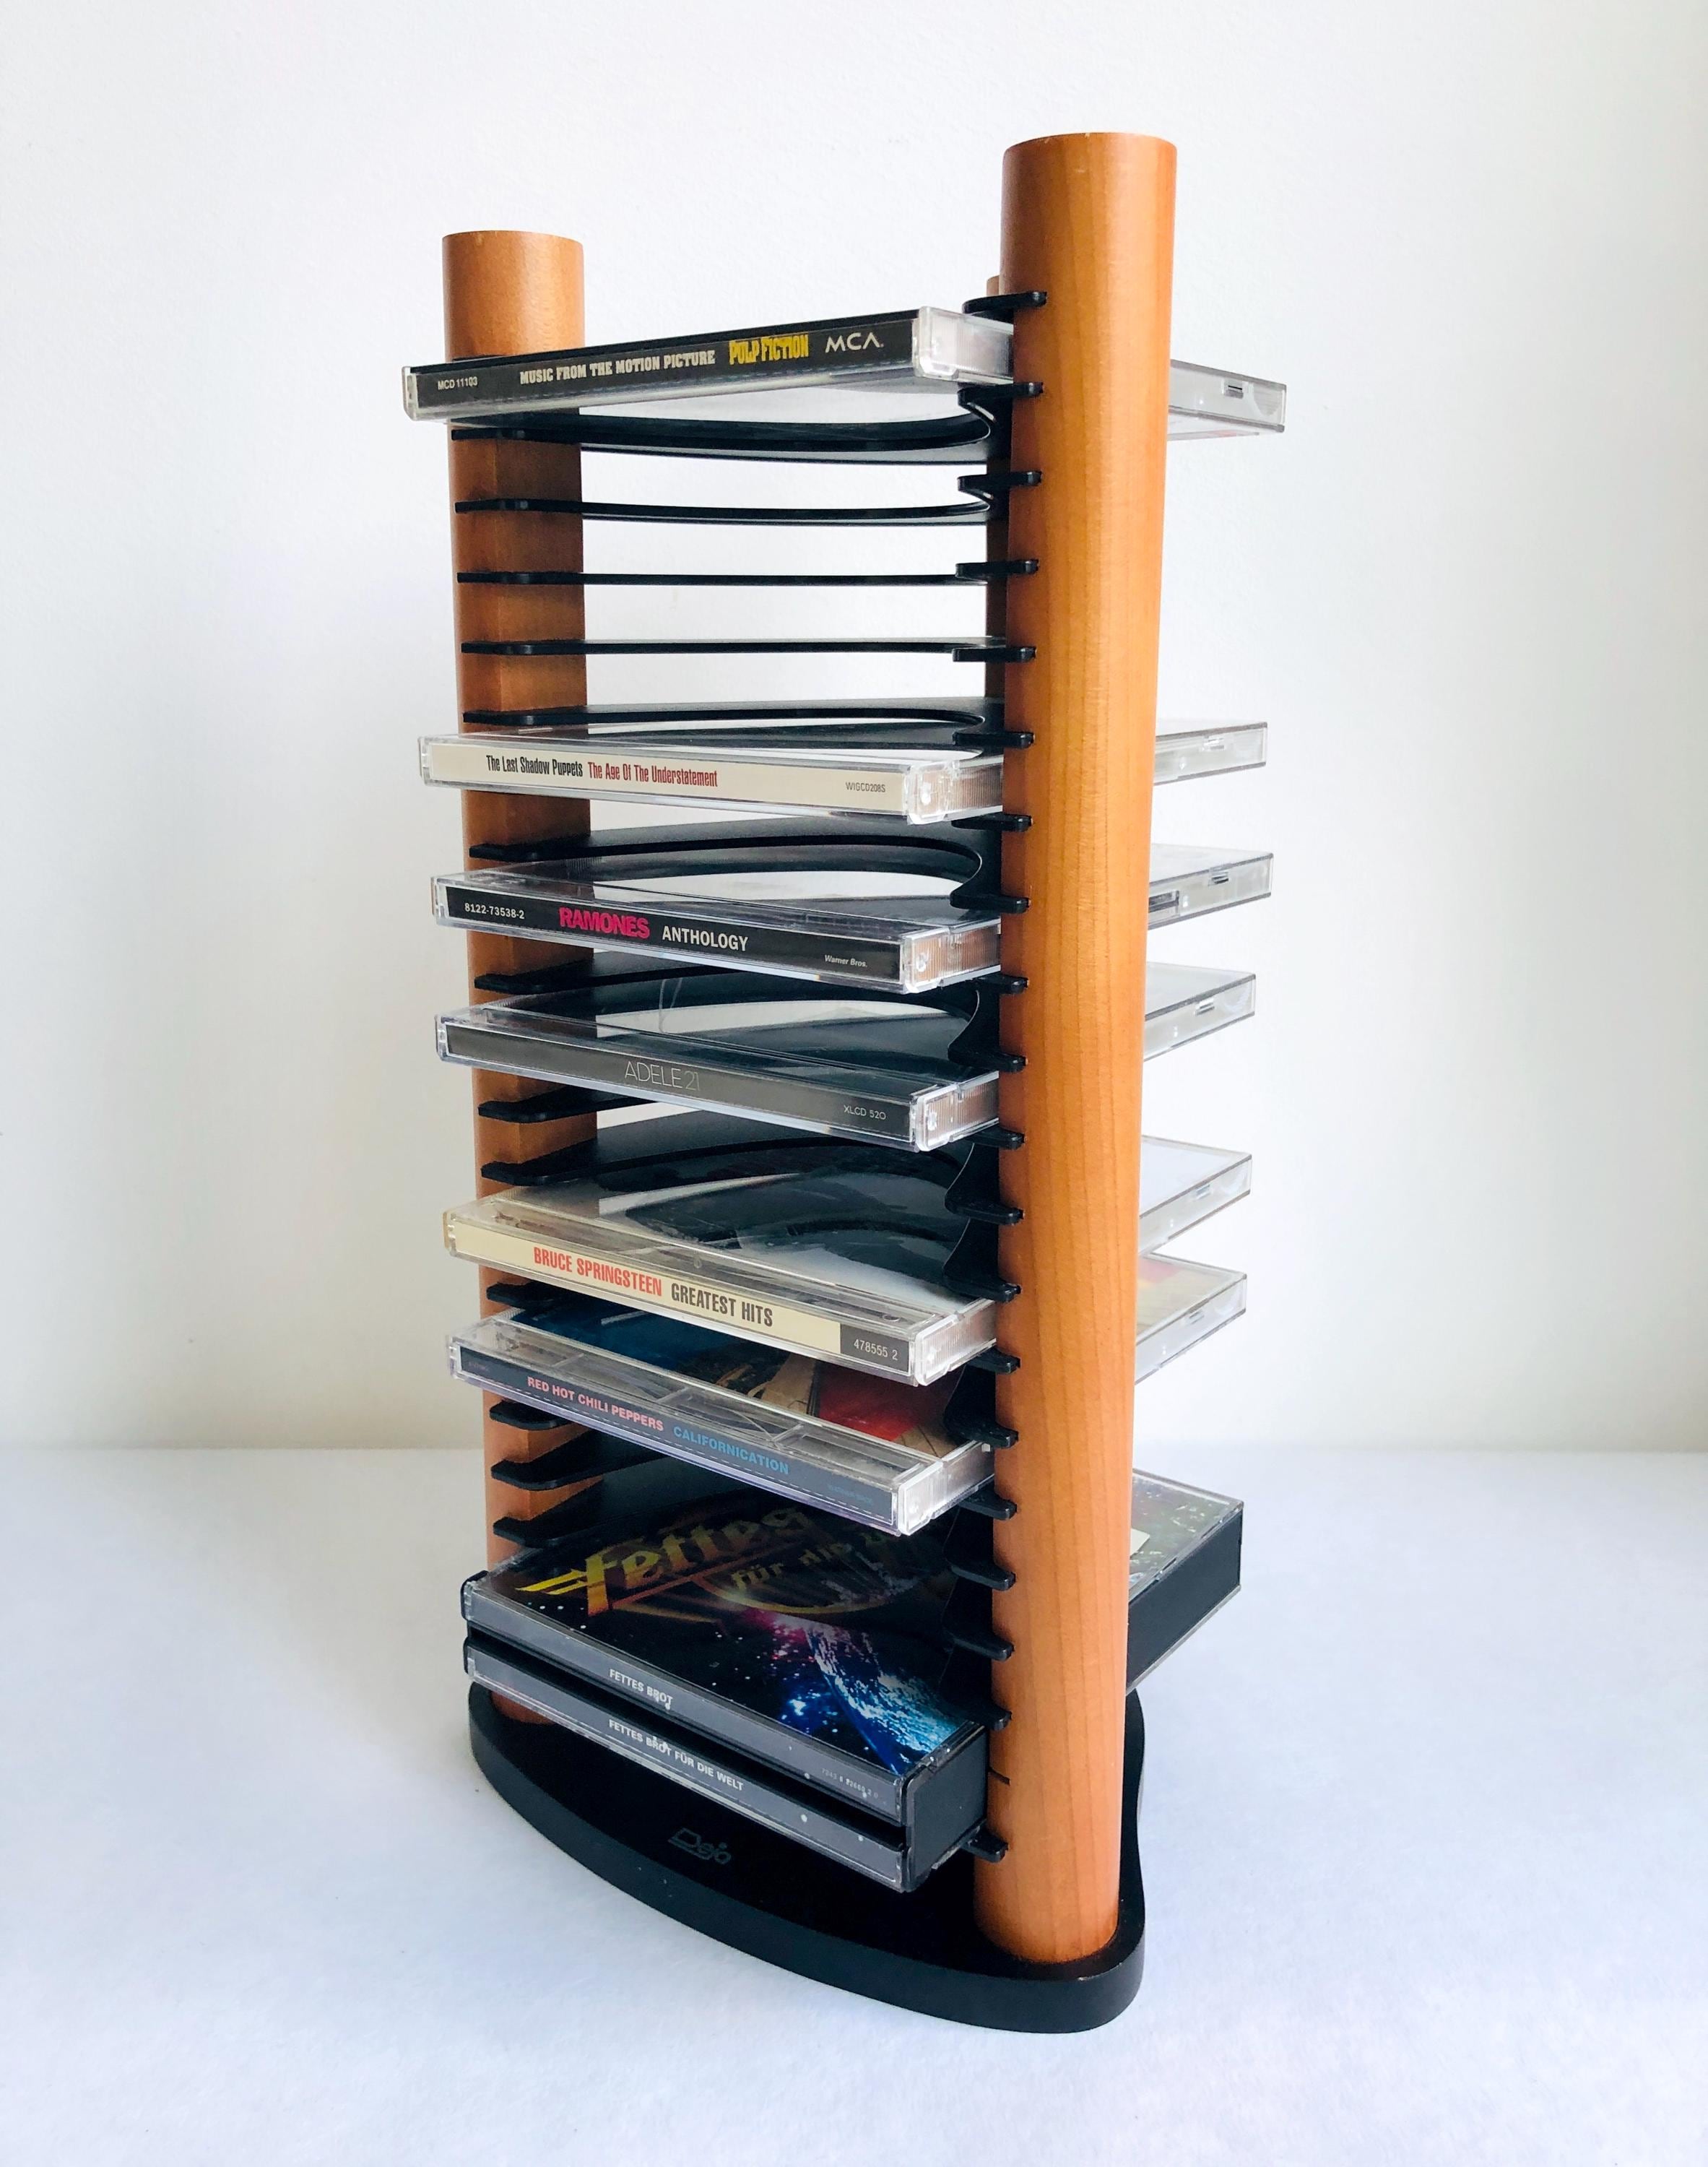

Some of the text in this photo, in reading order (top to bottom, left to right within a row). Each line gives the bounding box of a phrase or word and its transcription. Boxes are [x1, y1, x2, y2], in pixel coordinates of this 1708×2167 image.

[438, 379, 455, 390] MCD
[456, 376, 477, 388] 11103
[520, 370, 553, 385] MUSIC
[556, 364, 586, 381] FROM
[590, 362, 612, 376] THE
[615, 356, 660, 374] MOTION
[664, 350, 716, 370] PICTURE
[729, 339, 759, 365] PULP
[761, 333, 809, 362] FICTION
[486, 755, 885, 792] The Last Shadow Puppets The Age Of The Understatement WIGCD208S
[464, 902, 525, 920] 8122-73538-2
[559, 907, 650, 938] RAMONES
[662, 925, 749, 952] ANTHOLOGY
[825, 954, 849, 964] Warner
[625, 1060, 886, 1120] ADELE 21 XLCD 520
[533, 1247, 898, 1360] BRUCE SPRINGSTEEN GREATEST HITS 478555 2
[527, 1376, 789, 1474] RED HOT CHILI PEPPERS CALIFORNICATION
[609, 1669, 644, 1692] FETTES
[647, 1686, 673, 1705] BROT
[609, 1719, 743, 1791] FETTES BROT FÜR DIE WELT
